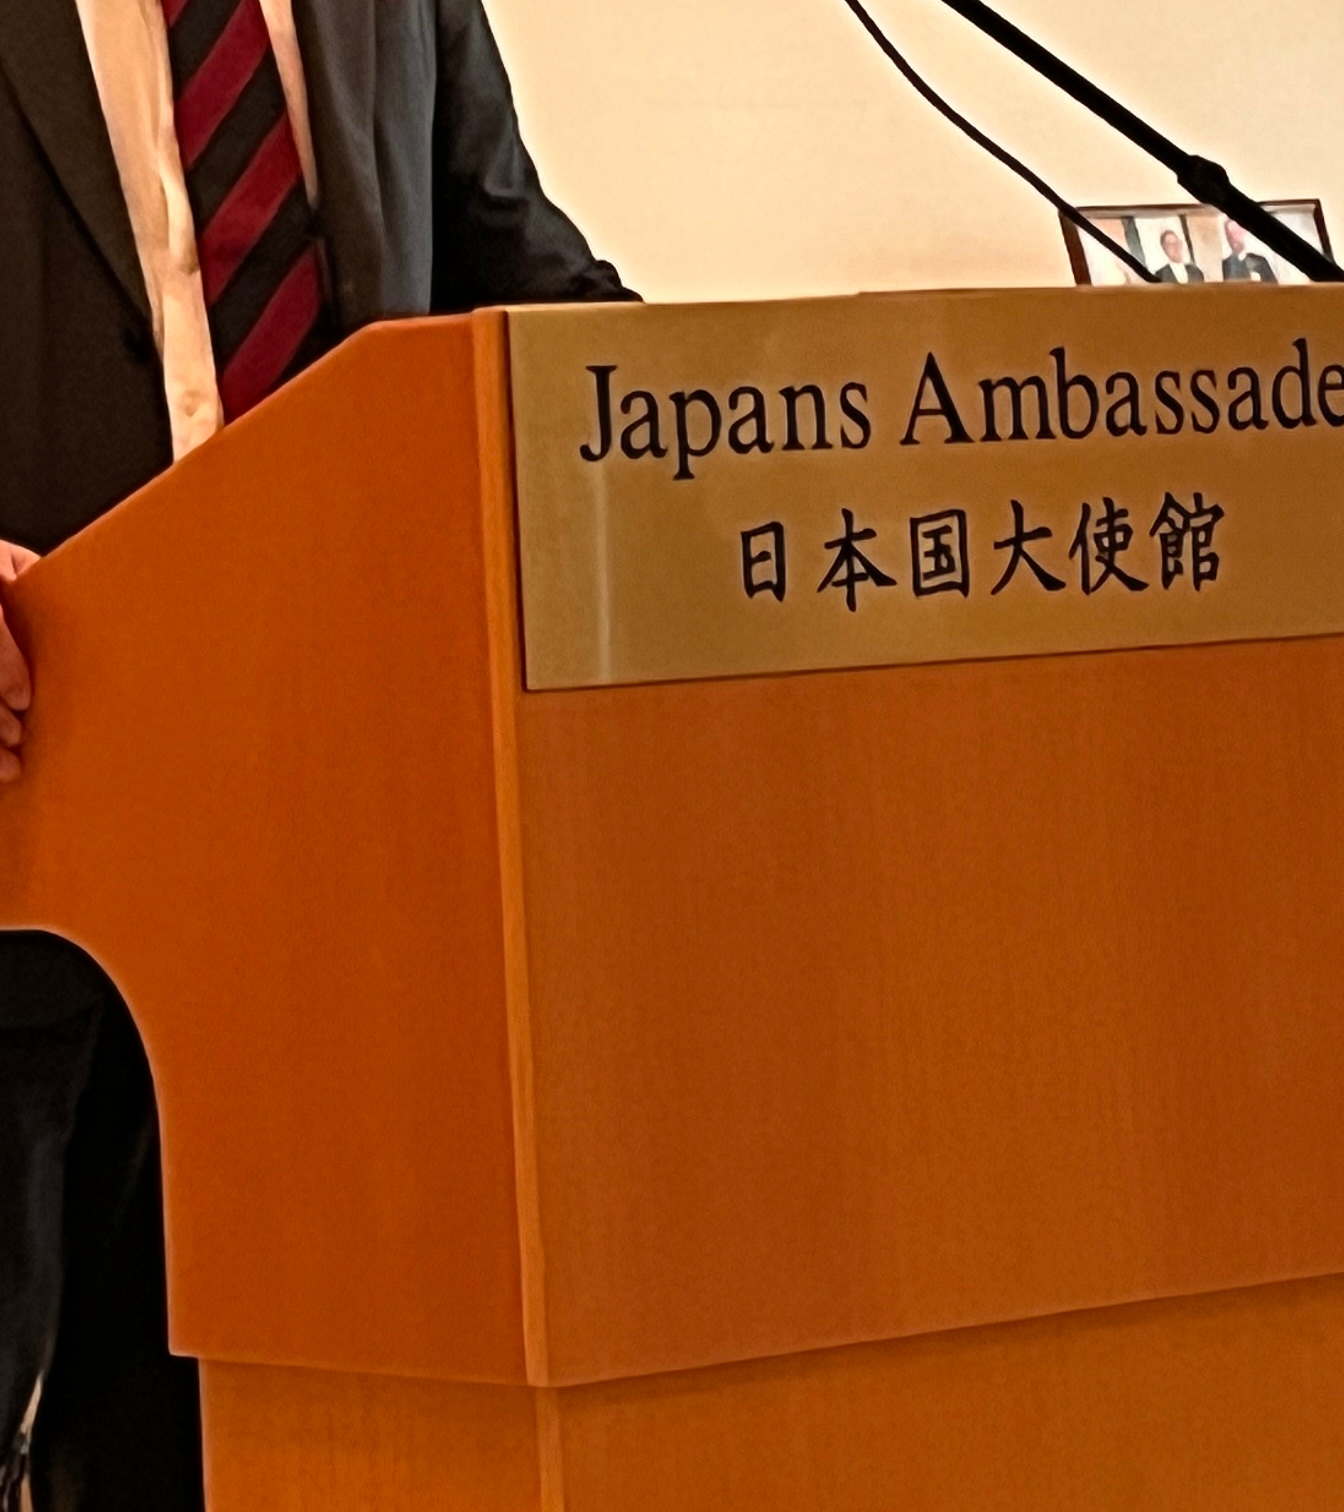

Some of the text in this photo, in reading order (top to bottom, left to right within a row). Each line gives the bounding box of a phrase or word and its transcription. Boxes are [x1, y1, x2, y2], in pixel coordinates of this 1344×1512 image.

[579, 364, 871, 481] Japans
[740, 491, 1224, 612] 日本国大使館
